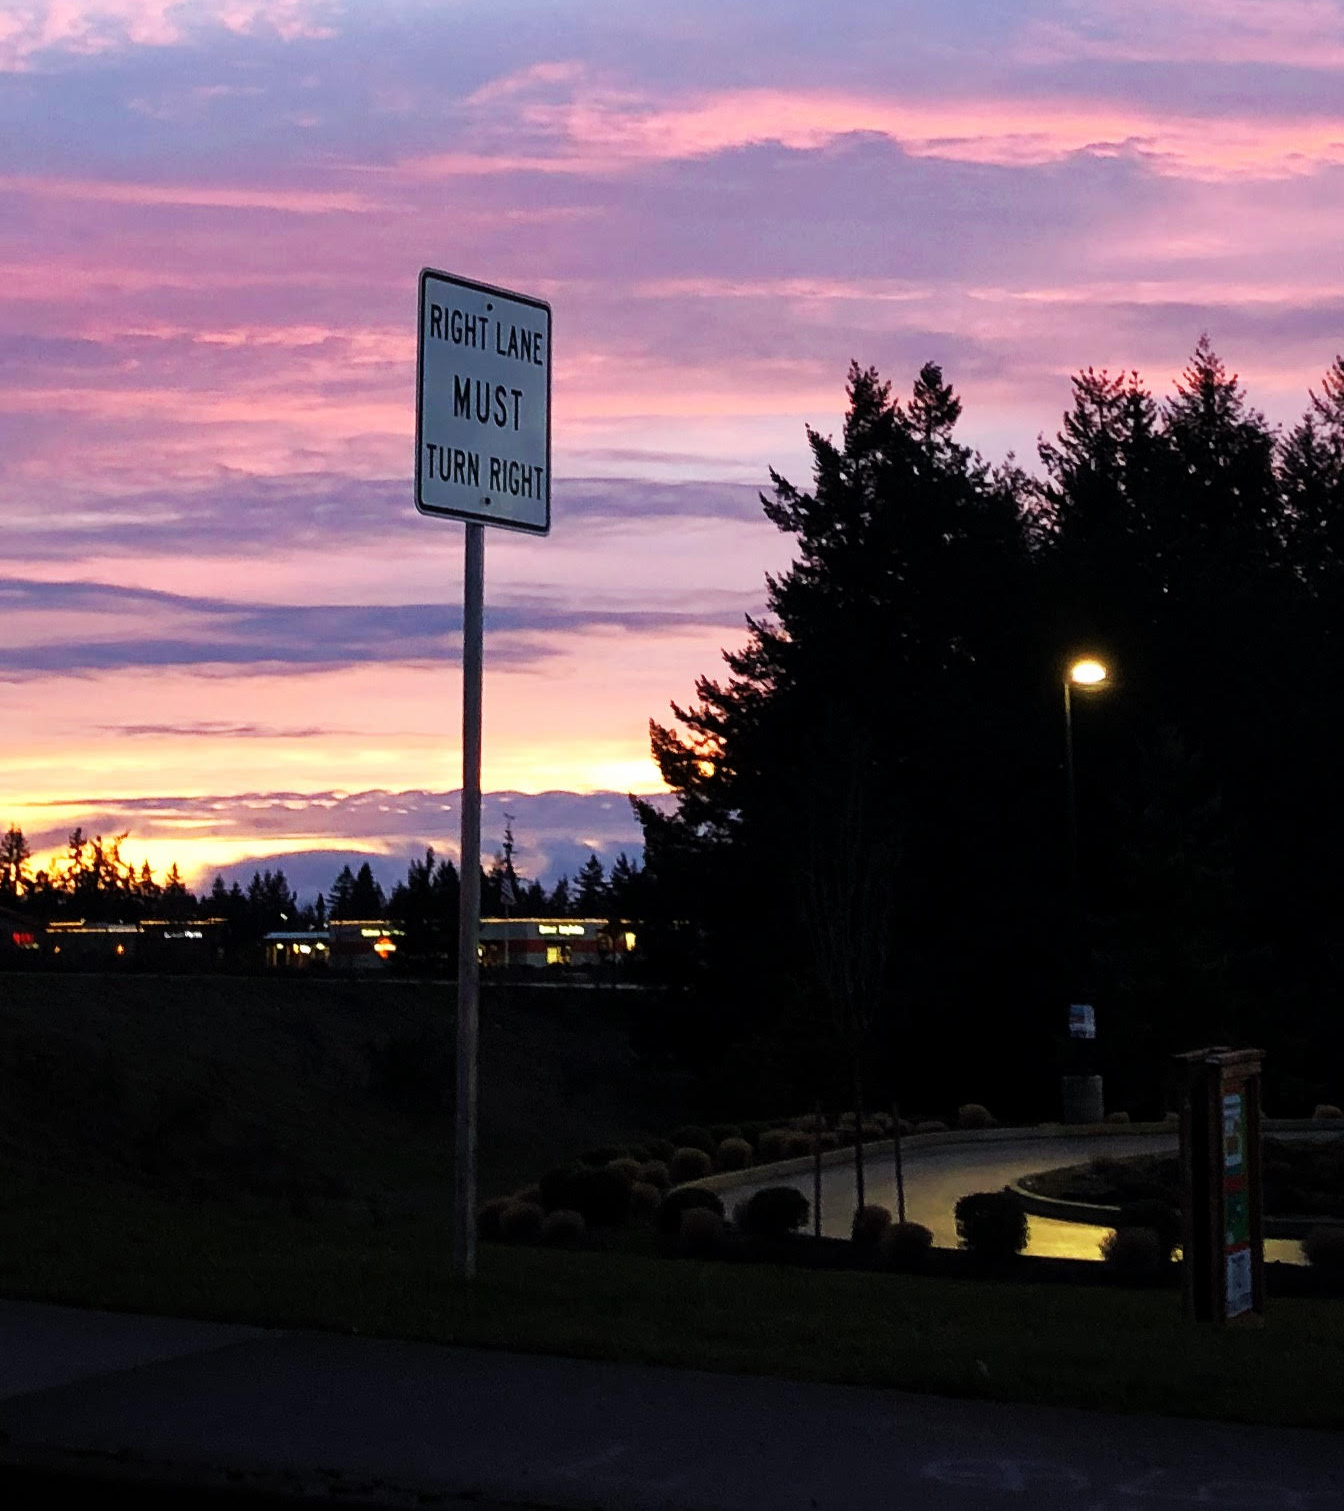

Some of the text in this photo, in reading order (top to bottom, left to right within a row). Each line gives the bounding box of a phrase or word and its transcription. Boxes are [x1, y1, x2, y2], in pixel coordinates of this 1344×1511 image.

[429, 304, 543, 366] RIGHT LANE
[453, 374, 523, 431] MUST
[426, 443, 544, 500] TURN RIGHT
